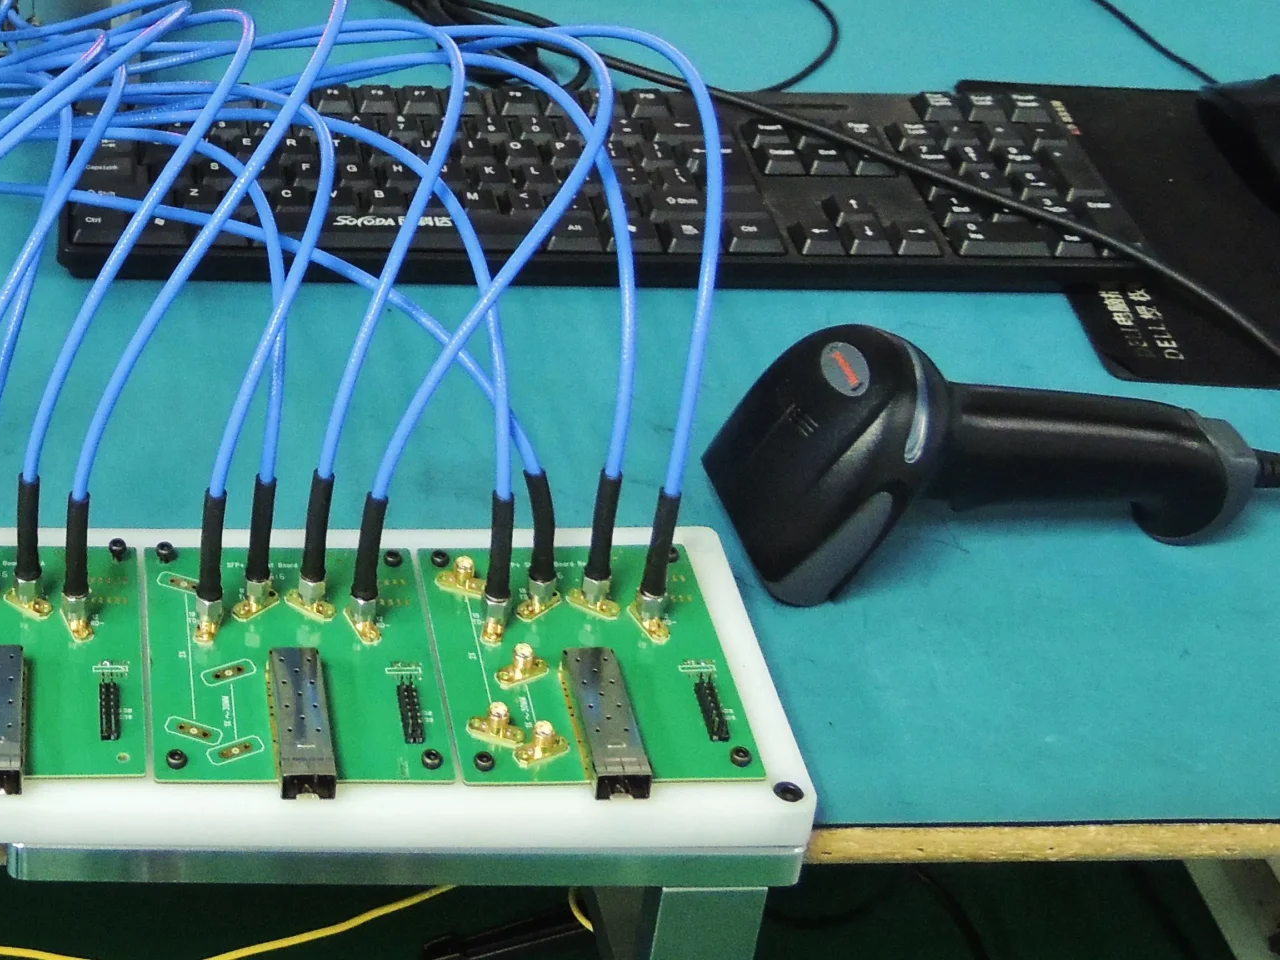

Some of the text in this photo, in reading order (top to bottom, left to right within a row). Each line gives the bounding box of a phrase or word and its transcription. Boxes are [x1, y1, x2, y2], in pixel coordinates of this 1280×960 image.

[242, 138, 252, 146] E
[286, 138, 297, 147] R
[421, 140, 431, 148] U
[510, 142, 521, 150] O
[555, 142, 565, 150] P
[302, 163, 310, 171] F
[347, 164, 358, 173] G
[392, 164, 403, 173] H
[484, 166, 496, 174] K
[530, 167, 539, 175] L
[190, 188, 199, 196] Z
[281, 190, 292, 198] C
[374, 190, 385, 198] B
[467, 192, 478, 200] M
